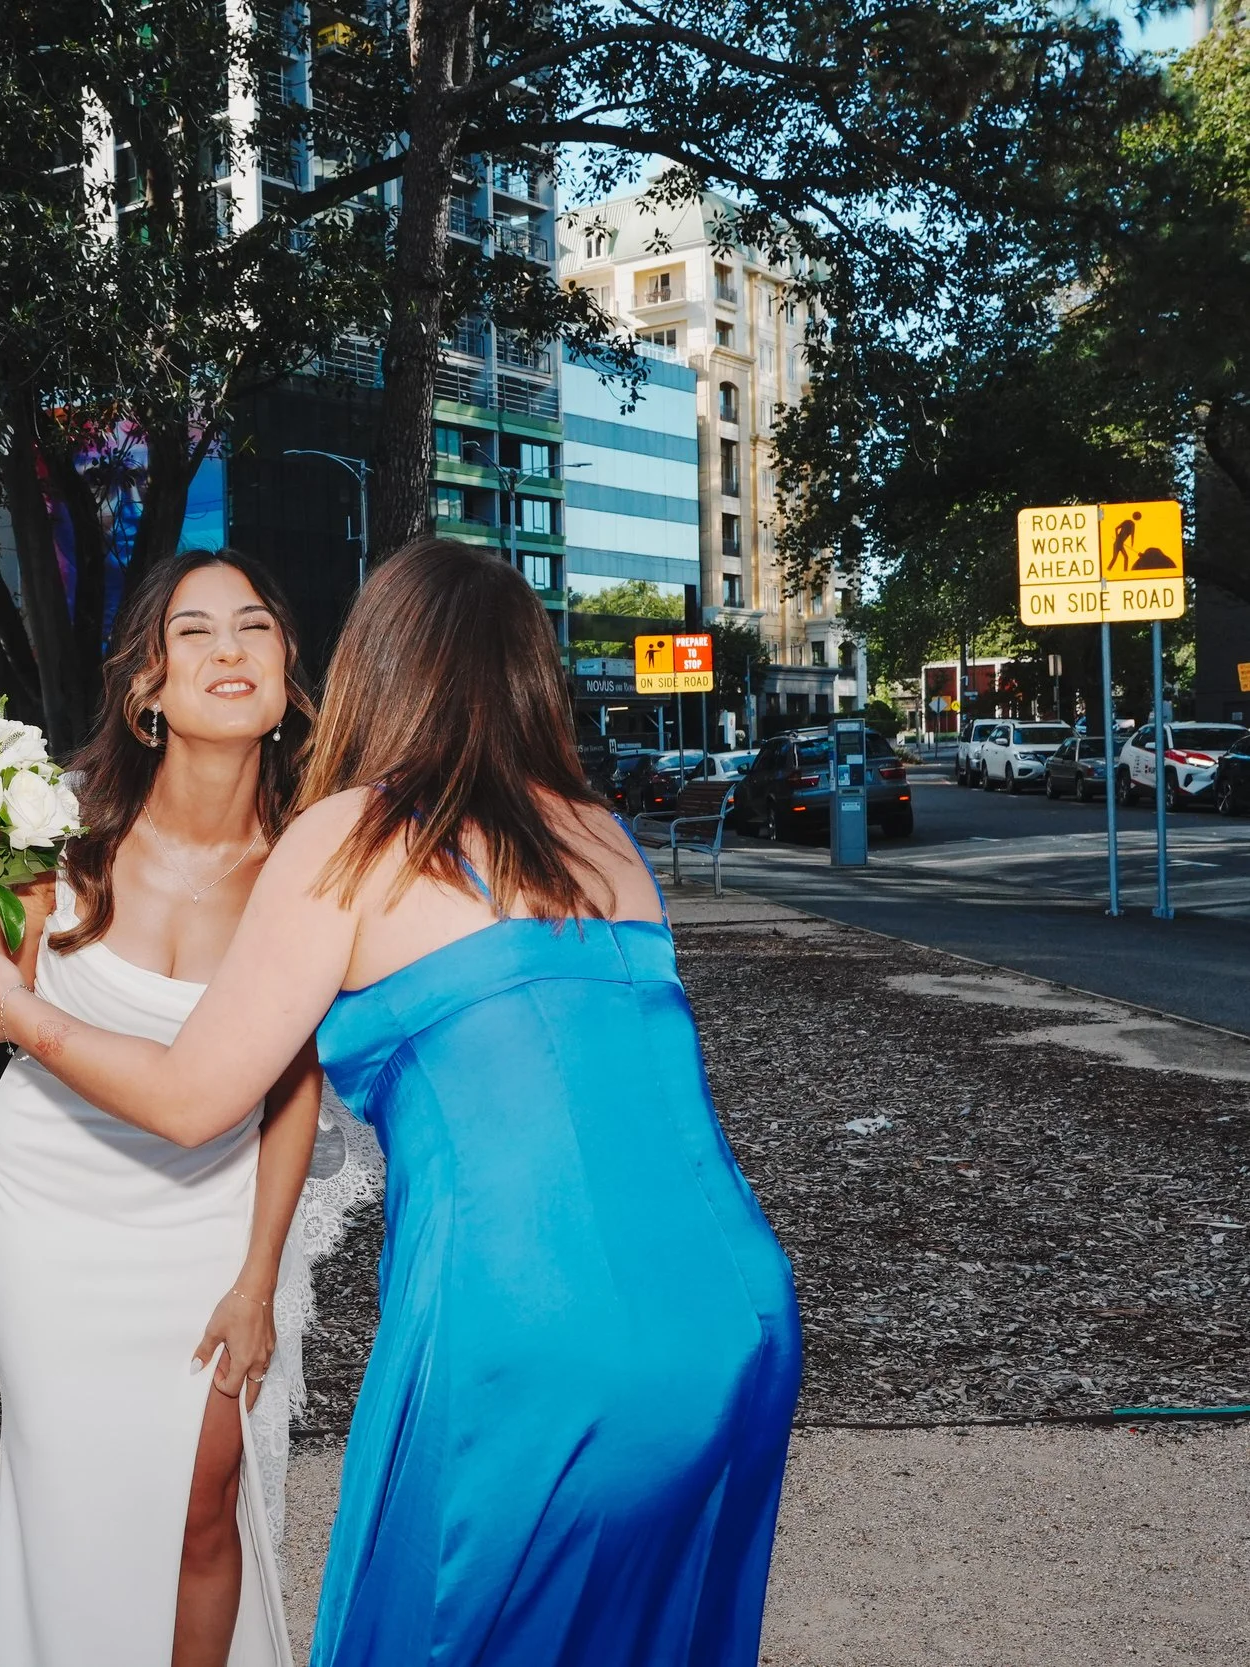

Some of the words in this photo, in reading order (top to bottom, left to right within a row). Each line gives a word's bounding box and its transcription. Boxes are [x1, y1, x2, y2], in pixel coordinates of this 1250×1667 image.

[1031, 512, 1086, 531] ROAD
[1031, 536, 1087, 555] WORK
[1026, 559, 1095, 579] AHEAD
[1030, 593, 1055, 615] ON
[1067, 591, 1111, 613] SIDE
[1123, 588, 1175, 610] ROAD
[675, 637, 708, 647] PREPARE
[687, 648, 697, 658] TO
[683, 660, 702, 669] STOP
[586, 680, 615, 692] NOVUS
[640, 678, 653, 688] ON
[658, 677, 679, 688] SIDE
[684, 676, 709, 687] ROAD
